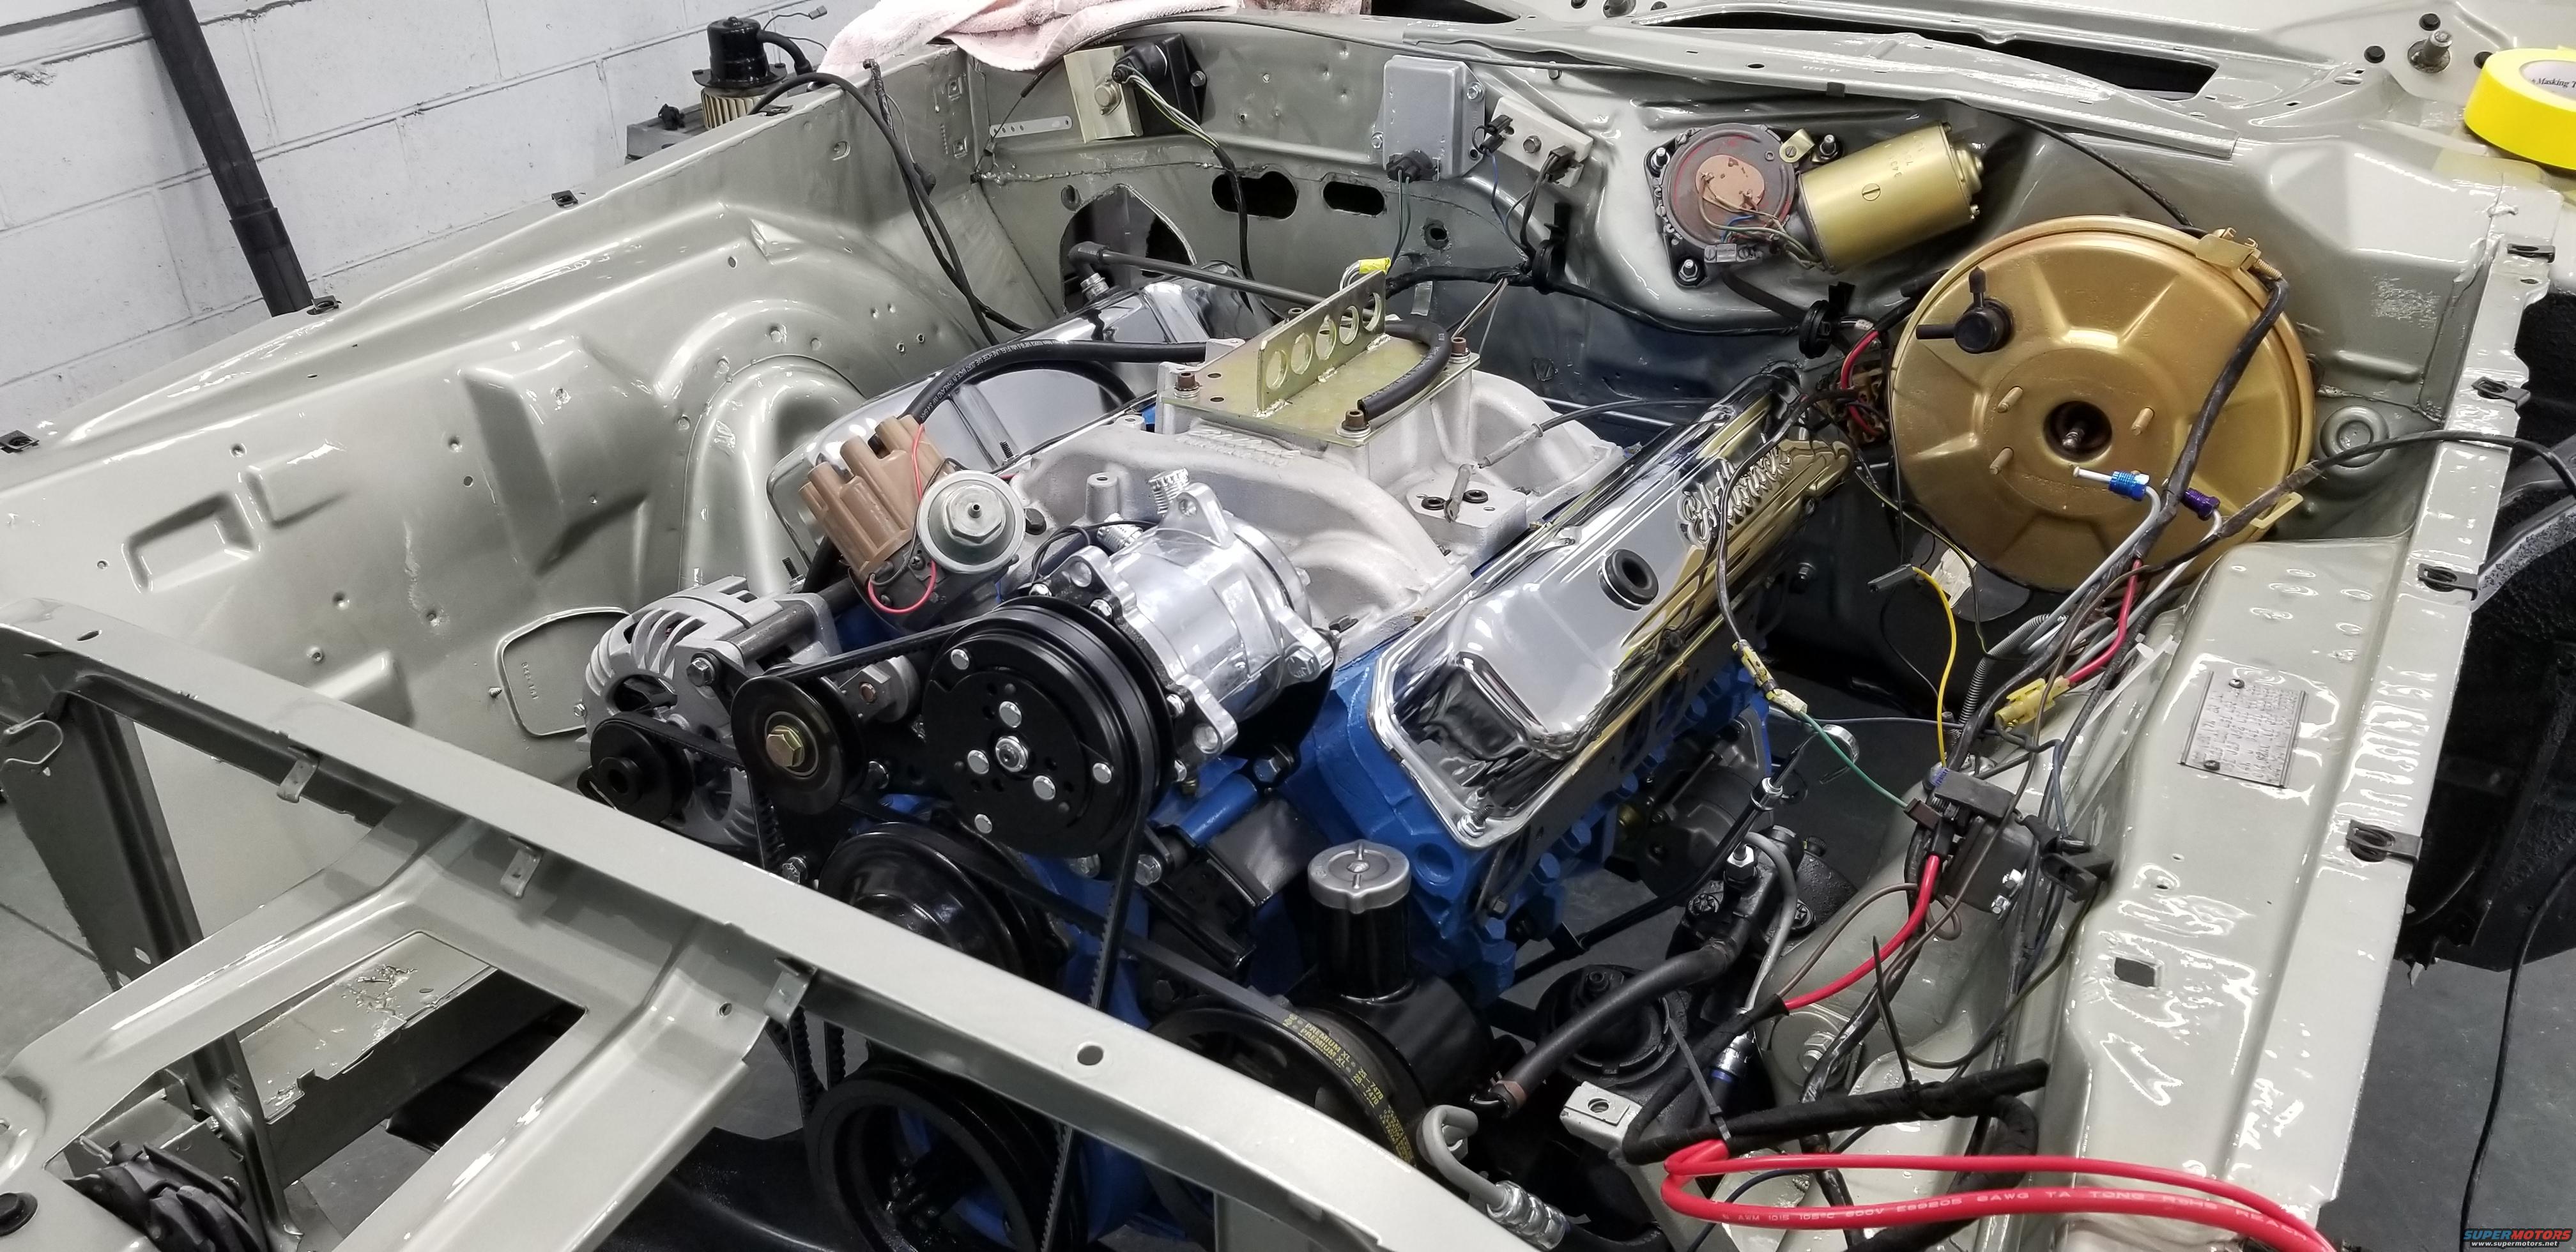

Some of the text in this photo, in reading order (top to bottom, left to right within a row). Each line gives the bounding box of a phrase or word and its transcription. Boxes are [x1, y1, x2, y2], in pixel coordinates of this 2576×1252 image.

[2538, 78, 2569, 88] Masking
[1300, 1028, 1337, 1058] PREMIUM
[1336, 1055, 1346, 1068] XL
[1305, 1023, 1341, 1053] PREMIUM
[1340, 1051, 1351, 1062] XL
